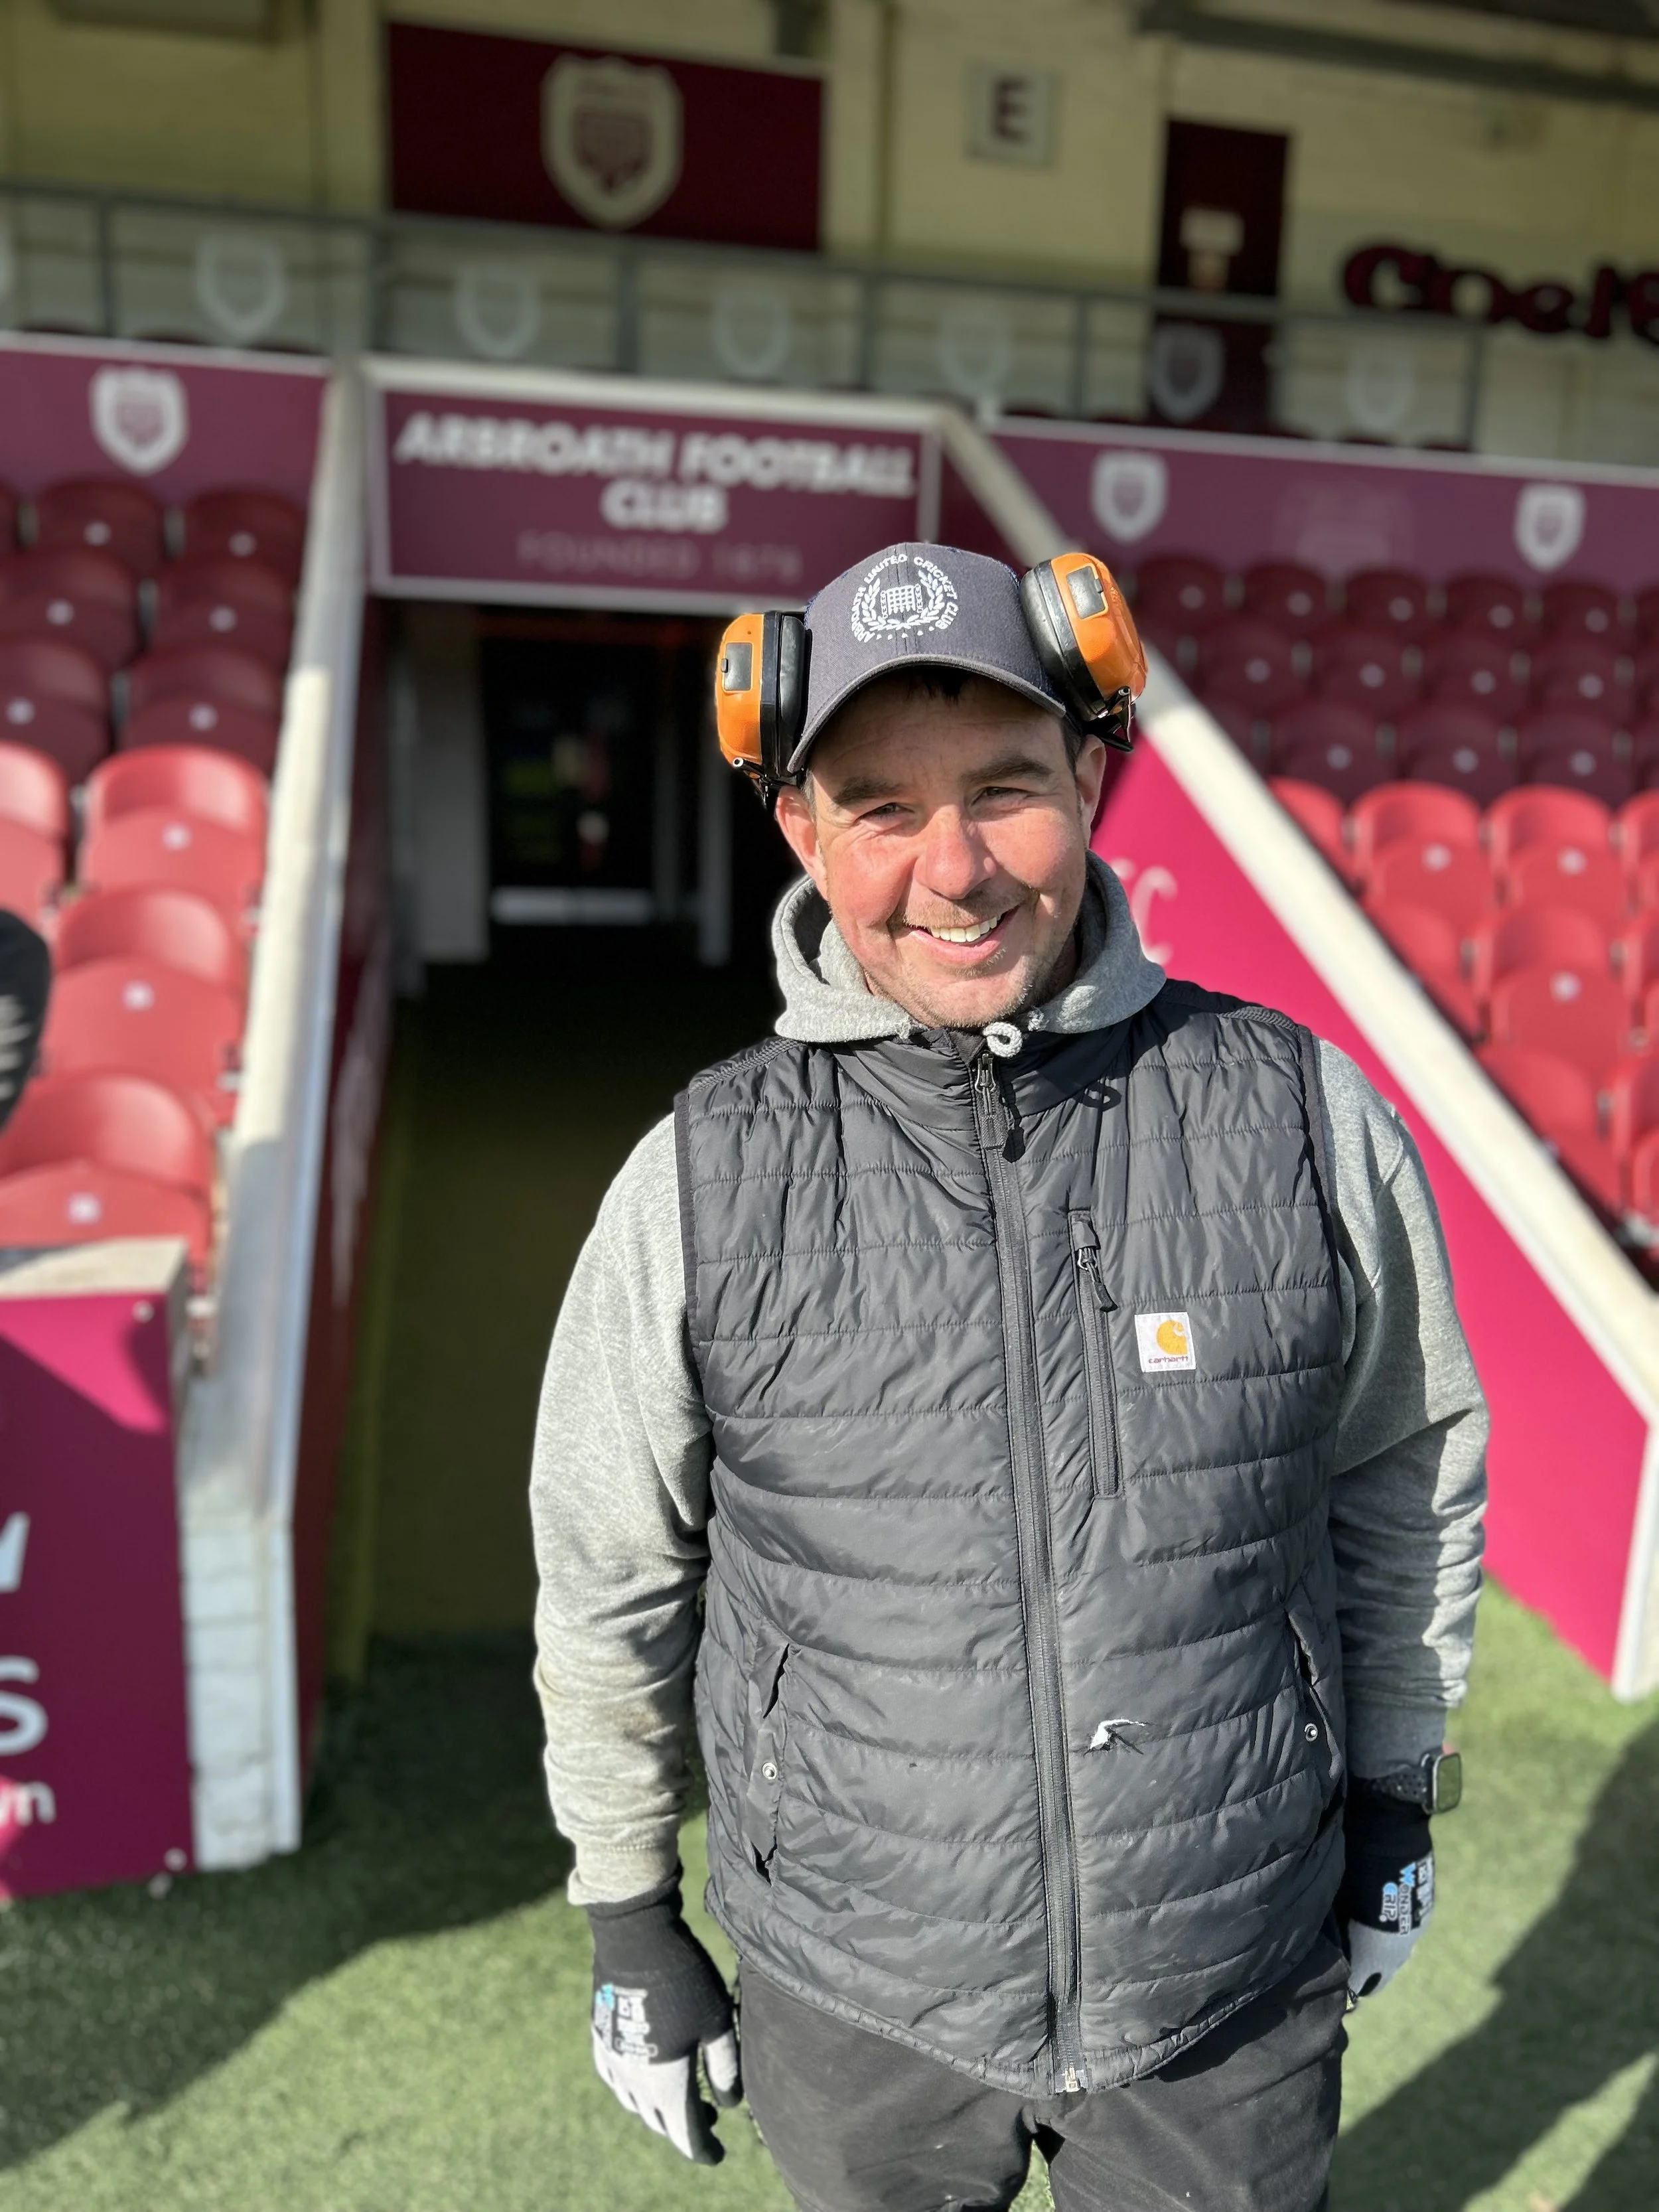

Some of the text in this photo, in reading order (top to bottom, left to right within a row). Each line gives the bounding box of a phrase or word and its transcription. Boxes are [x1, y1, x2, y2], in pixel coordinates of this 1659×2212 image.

[993, 74, 1030, 143] E
[396, 411, 918, 496] ARBROATH FOOTBALL
[601, 479, 728, 533] CLUB
[863, 553, 908, 584] UNITED
[914, 556, 958, 600] CRICKET
[935, 601, 959, 630] CLUB
[1148, 1356, 1189, 1364] carhartt
